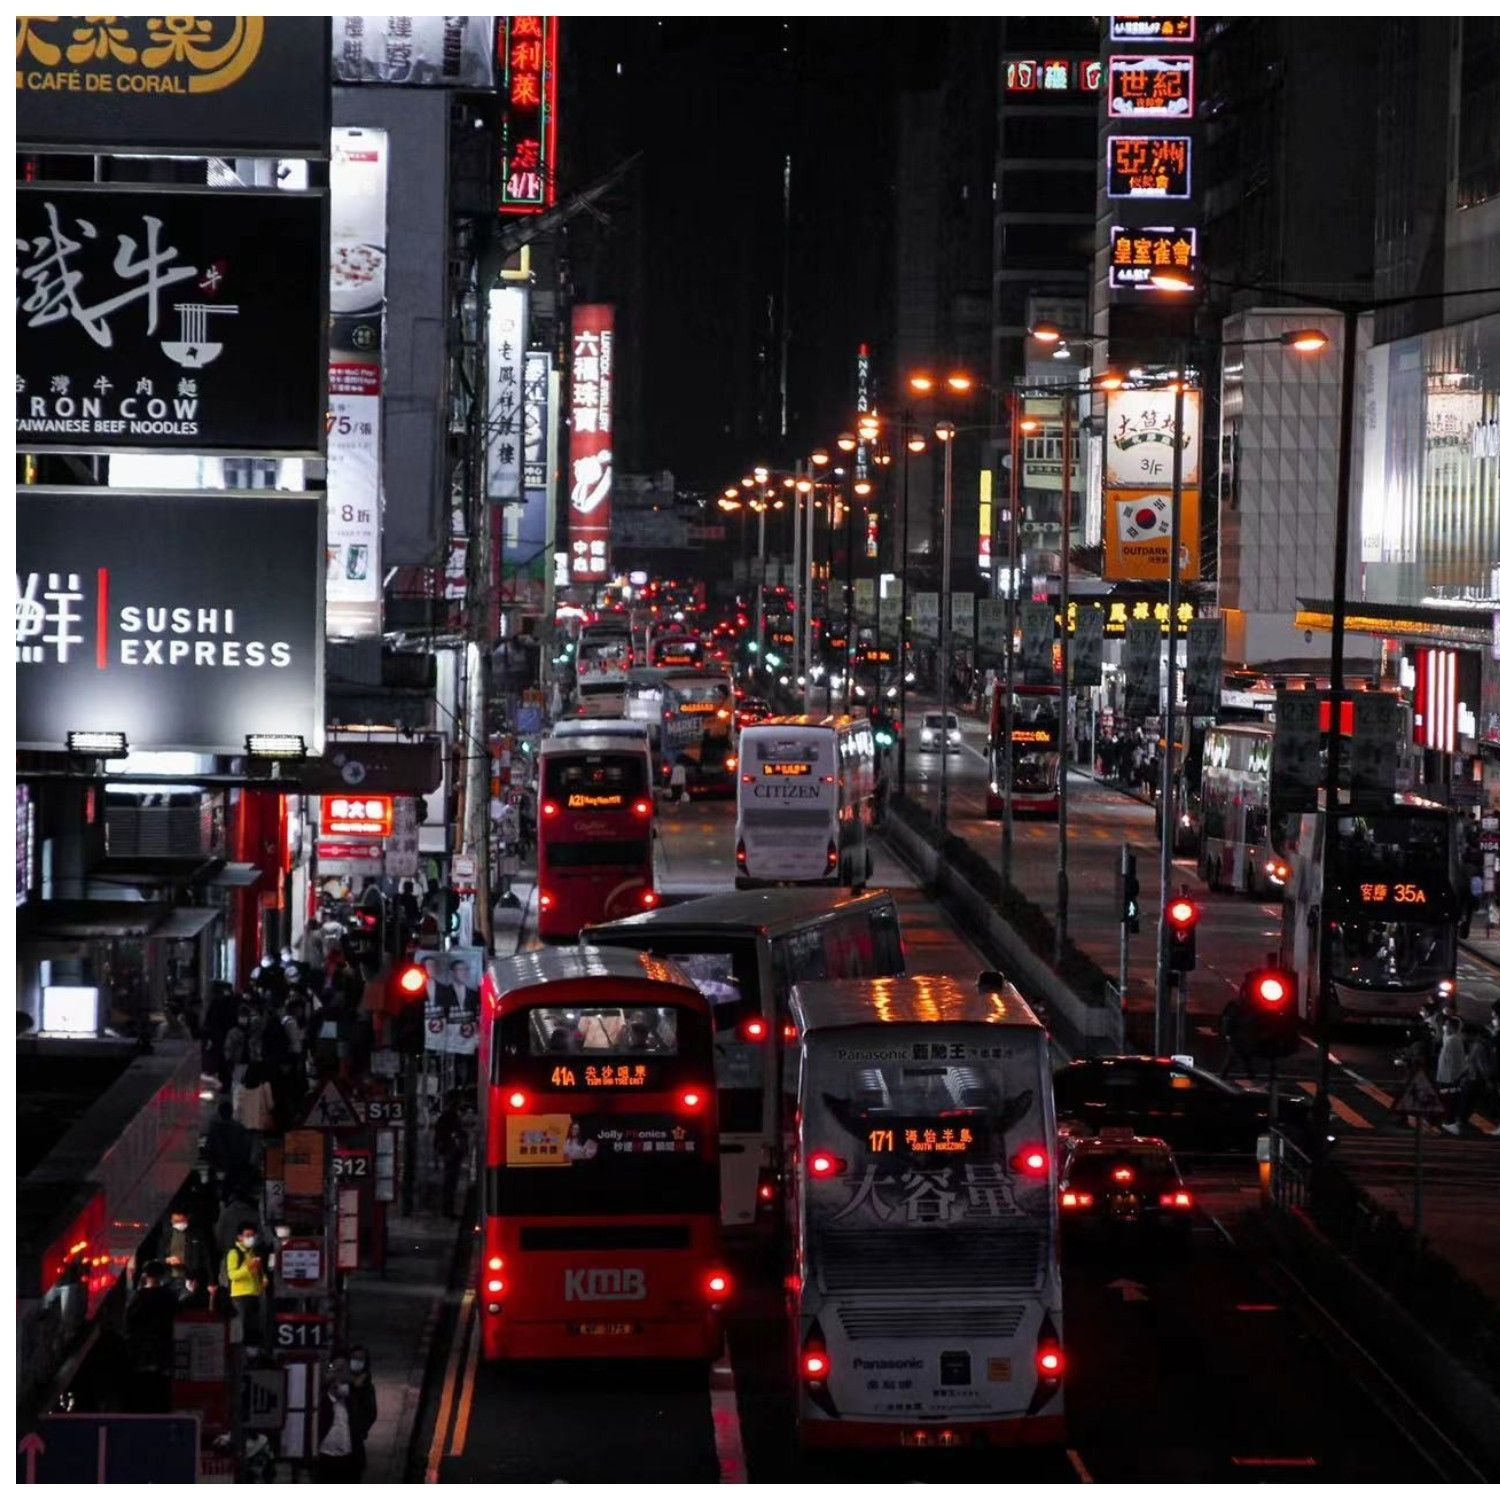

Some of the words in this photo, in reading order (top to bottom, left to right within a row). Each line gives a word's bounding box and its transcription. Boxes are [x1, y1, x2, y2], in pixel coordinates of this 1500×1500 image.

[28, 70, 80, 91] CAFÉ
[85, 74, 112, 92] DE
[116, 74, 186, 94] CORAL
[1120, 71, 1183, 98] 世紀
[573, 331, 600, 432] 六福珠寶
[31, 396, 101, 418] RON
[120, 397, 199, 420] COW
[93, 419, 126, 434] BEEF
[130, 420, 199, 435] NOODLES
[1141, 458, 1164, 476] 3/F
[120, 606, 235, 634] SUSHI
[120, 639, 292, 667] EXPRESS
[754, 784, 820, 799] CITIZEN
[1395, 884, 1426, 903] 35A
[838, 1047, 908, 1062] Panasonic
[552, 1065, 576, 1086] 41A
[369, 1103, 402, 1118] S13
[597, 1130, 623, 1141] Jolly
[869, 1131, 894, 1152] 171
[332, 1158, 367, 1175] S12
[836, 1162, 1026, 1222] 大容量
[564, 1269, 647, 1301] KMB
[278, 1324, 322, 1345] S11
[853, 1357, 923, 1370] Panasonic
